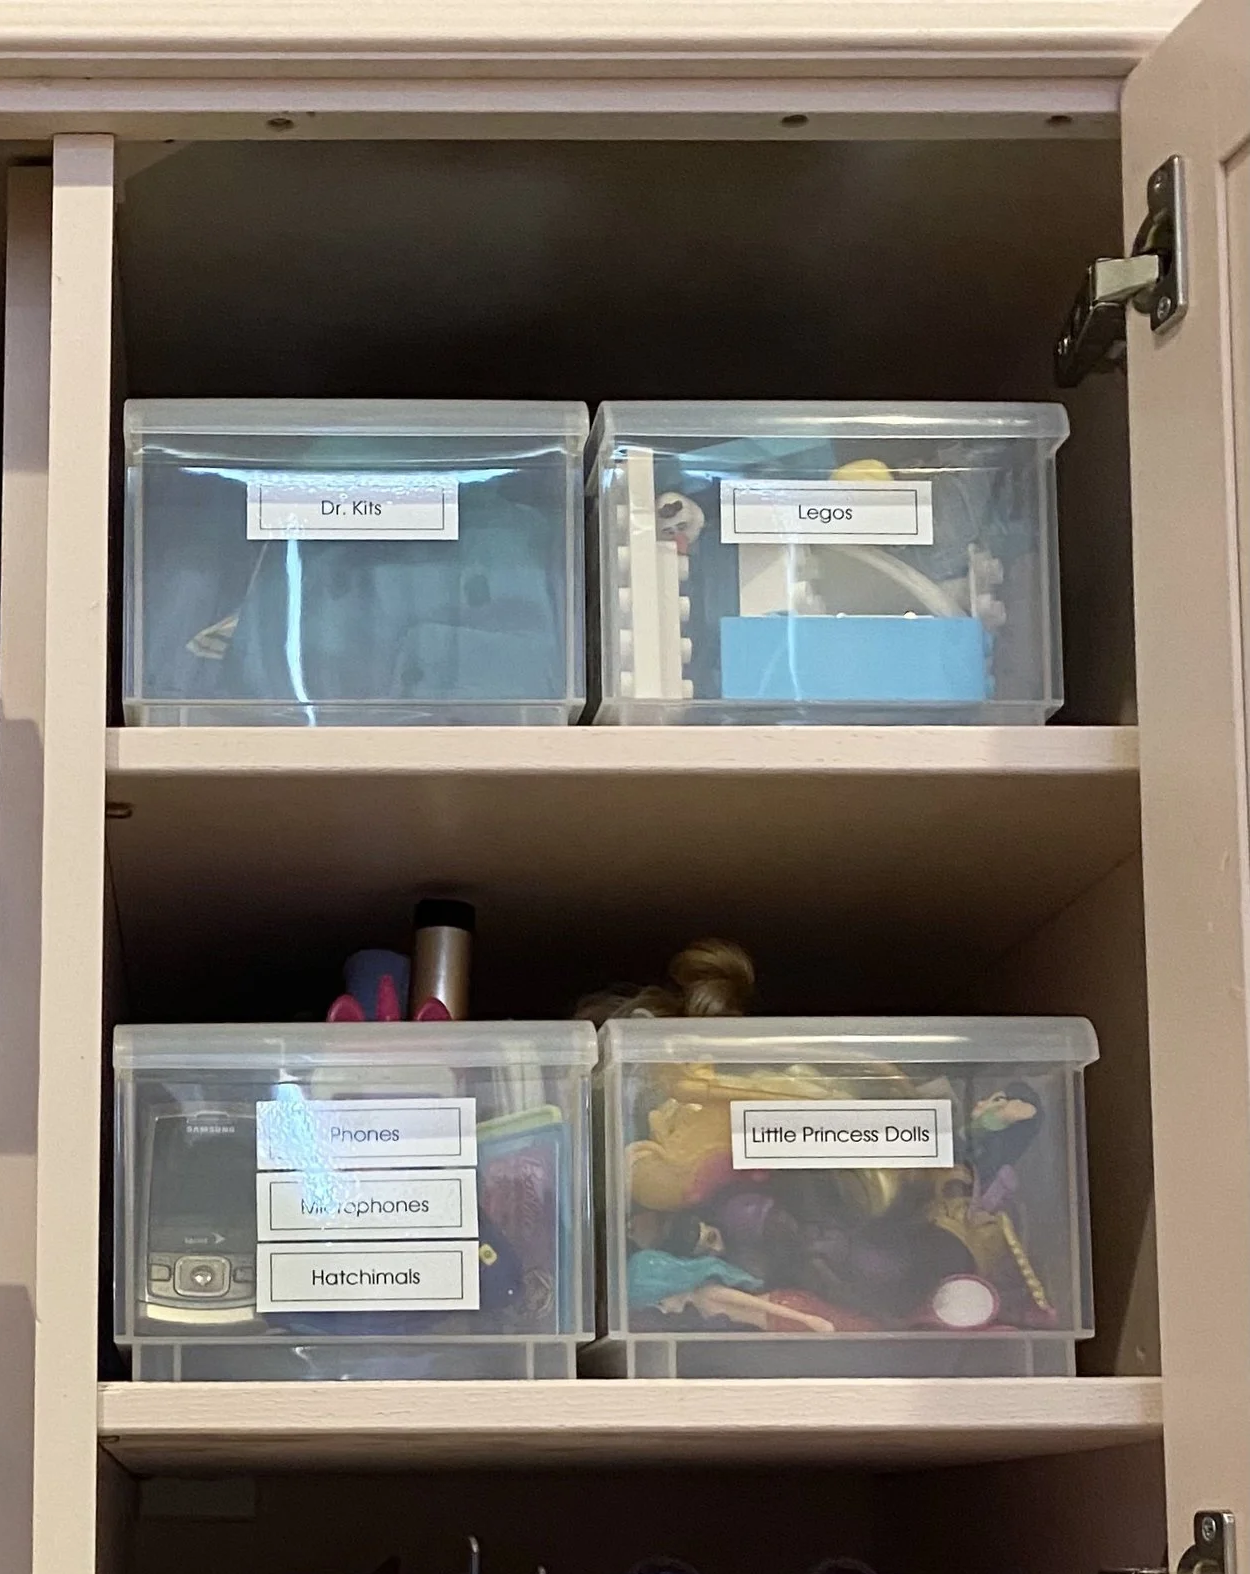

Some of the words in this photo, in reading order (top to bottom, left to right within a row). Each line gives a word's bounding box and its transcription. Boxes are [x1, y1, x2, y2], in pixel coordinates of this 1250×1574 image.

[321, 499, 346, 516] Dr.
[352, 500, 382, 516] Kits
[798, 504, 853, 524] Legos
[185, 1125, 236, 1133] SAMSUNG
[330, 1126, 400, 1143] Phones
[751, 1126, 797, 1144] Little
[802, 1126, 880, 1143] Princess
[885, 1125, 930, 1143] Dolls
[311, 1268, 421, 1286] Hatchimals
